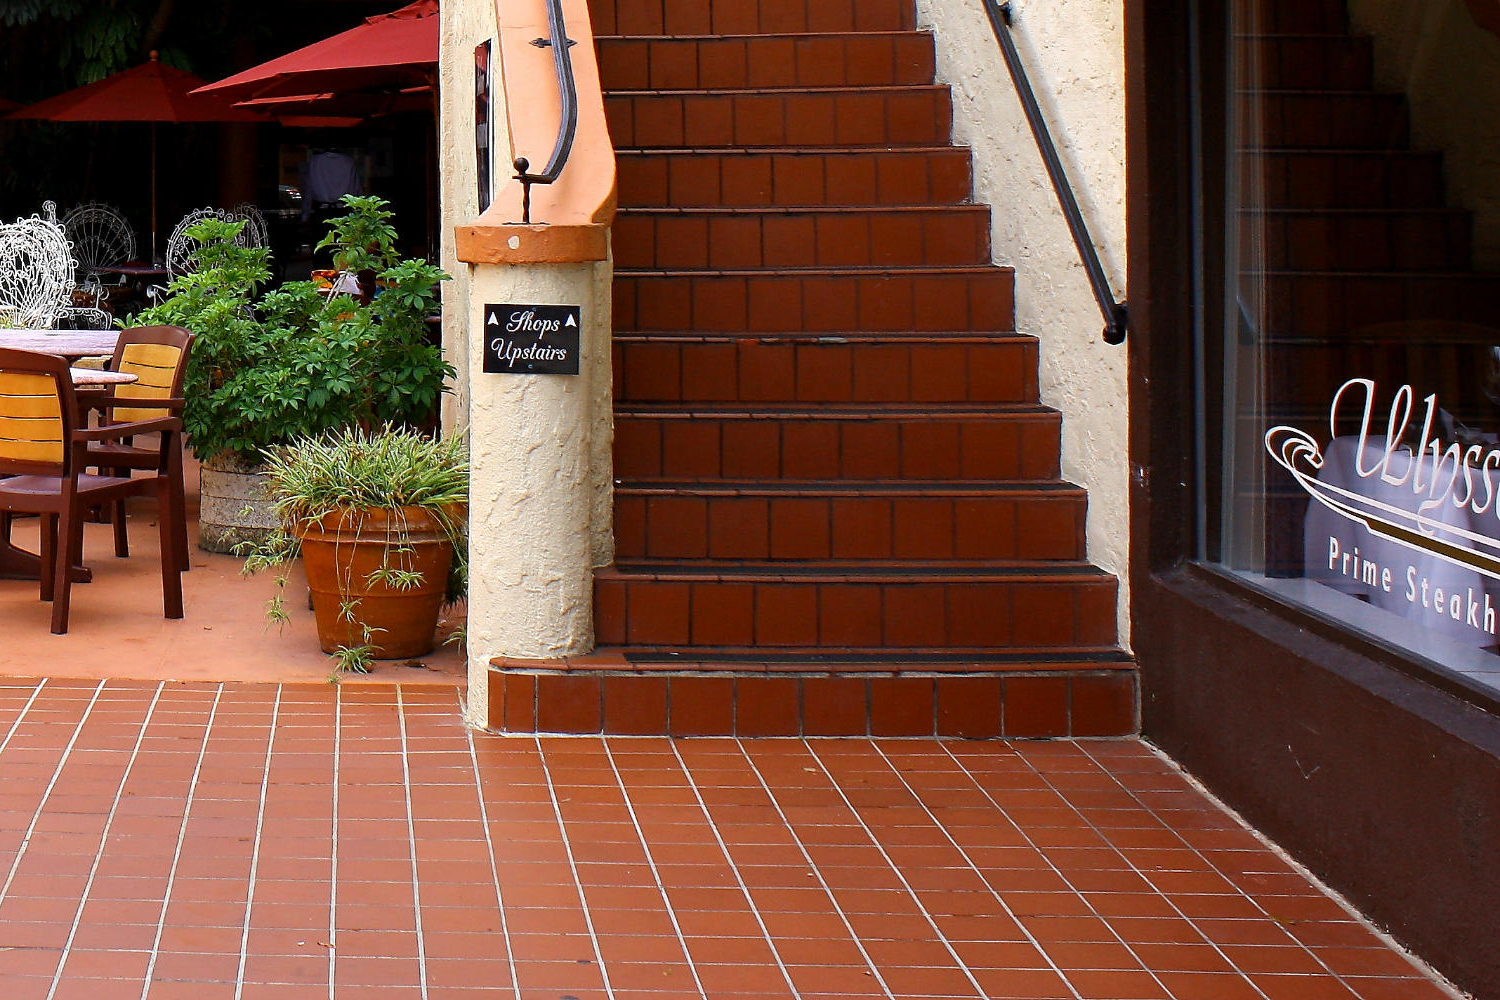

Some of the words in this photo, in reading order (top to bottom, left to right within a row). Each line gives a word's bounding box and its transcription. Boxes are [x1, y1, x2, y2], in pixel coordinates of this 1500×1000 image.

[491, 338, 567, 368] Upstairs
[506, 310, 561, 340] Shops
[1330, 378, 1500, 534] Ulyss
[1328, 536, 1393, 593] Prime
[1405, 565, 1496, 635] Steakh
